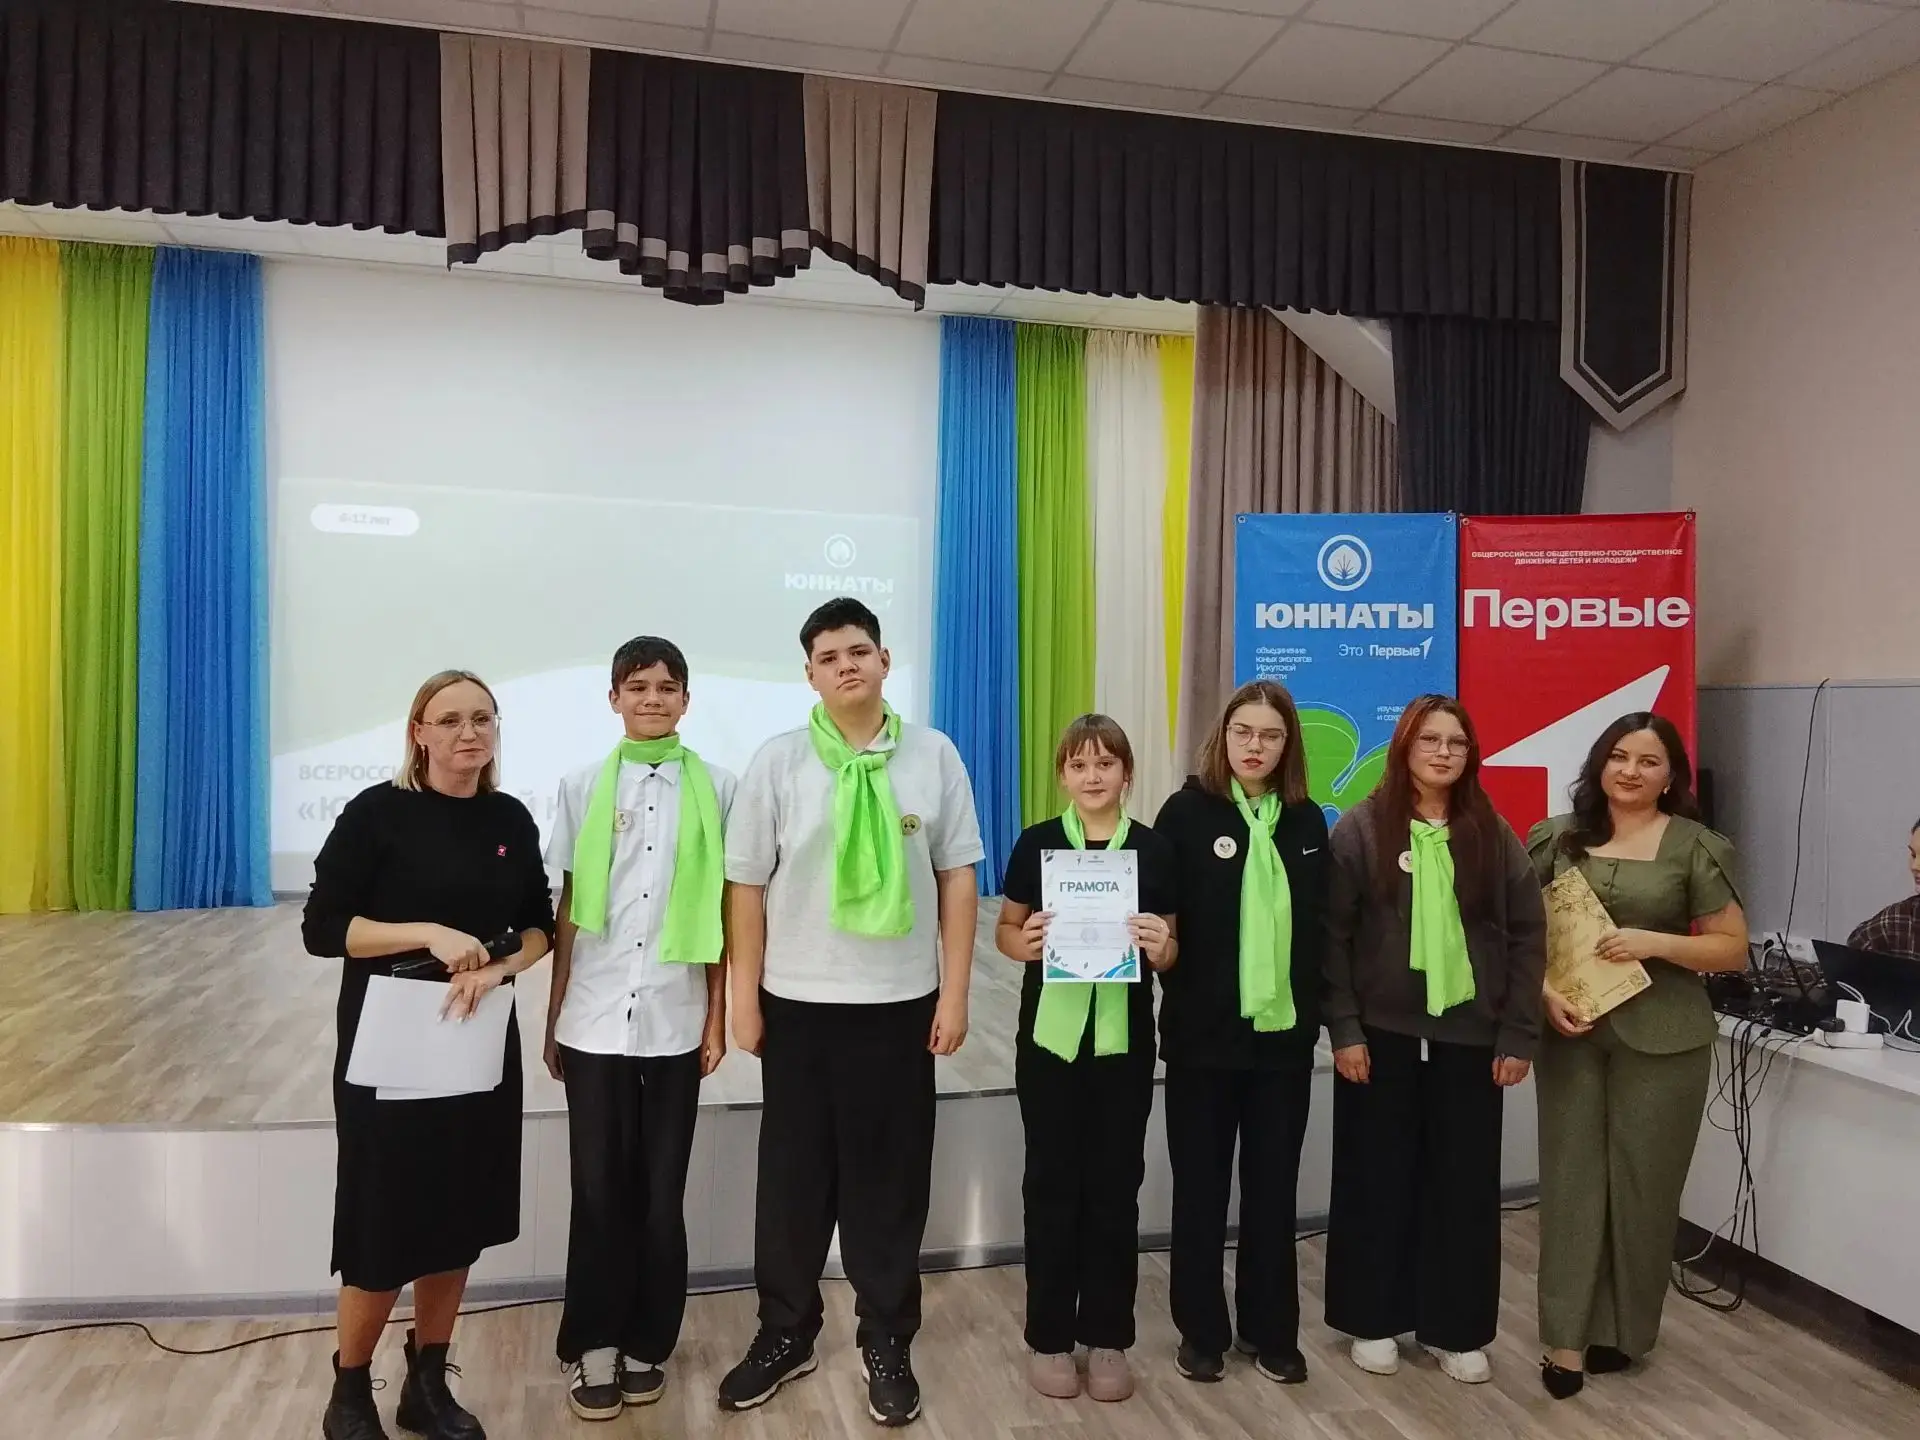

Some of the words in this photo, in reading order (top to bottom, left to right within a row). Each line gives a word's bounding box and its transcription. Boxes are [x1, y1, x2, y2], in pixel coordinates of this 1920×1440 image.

[1471, 550, 1545, 558] ОБЩЕРОССИЙСКОЕ
[1546, 549, 1683, 557] ОБЩЕСТВЕННО-ГОСУДАРСТВЕННОЕ
[1559, 557, 1584, 565] ДЕТЕЙ
[784, 572, 894, 594] ЮННАТЫ
[1255, 603, 1435, 629] ЮННАТЫ
[1463, 588, 1691, 640] Первые
[1338, 643, 1364, 657] Это
[1256, 663, 1297, 672] Иркутской
[1059, 881, 1120, 893] ГРАМОТА
